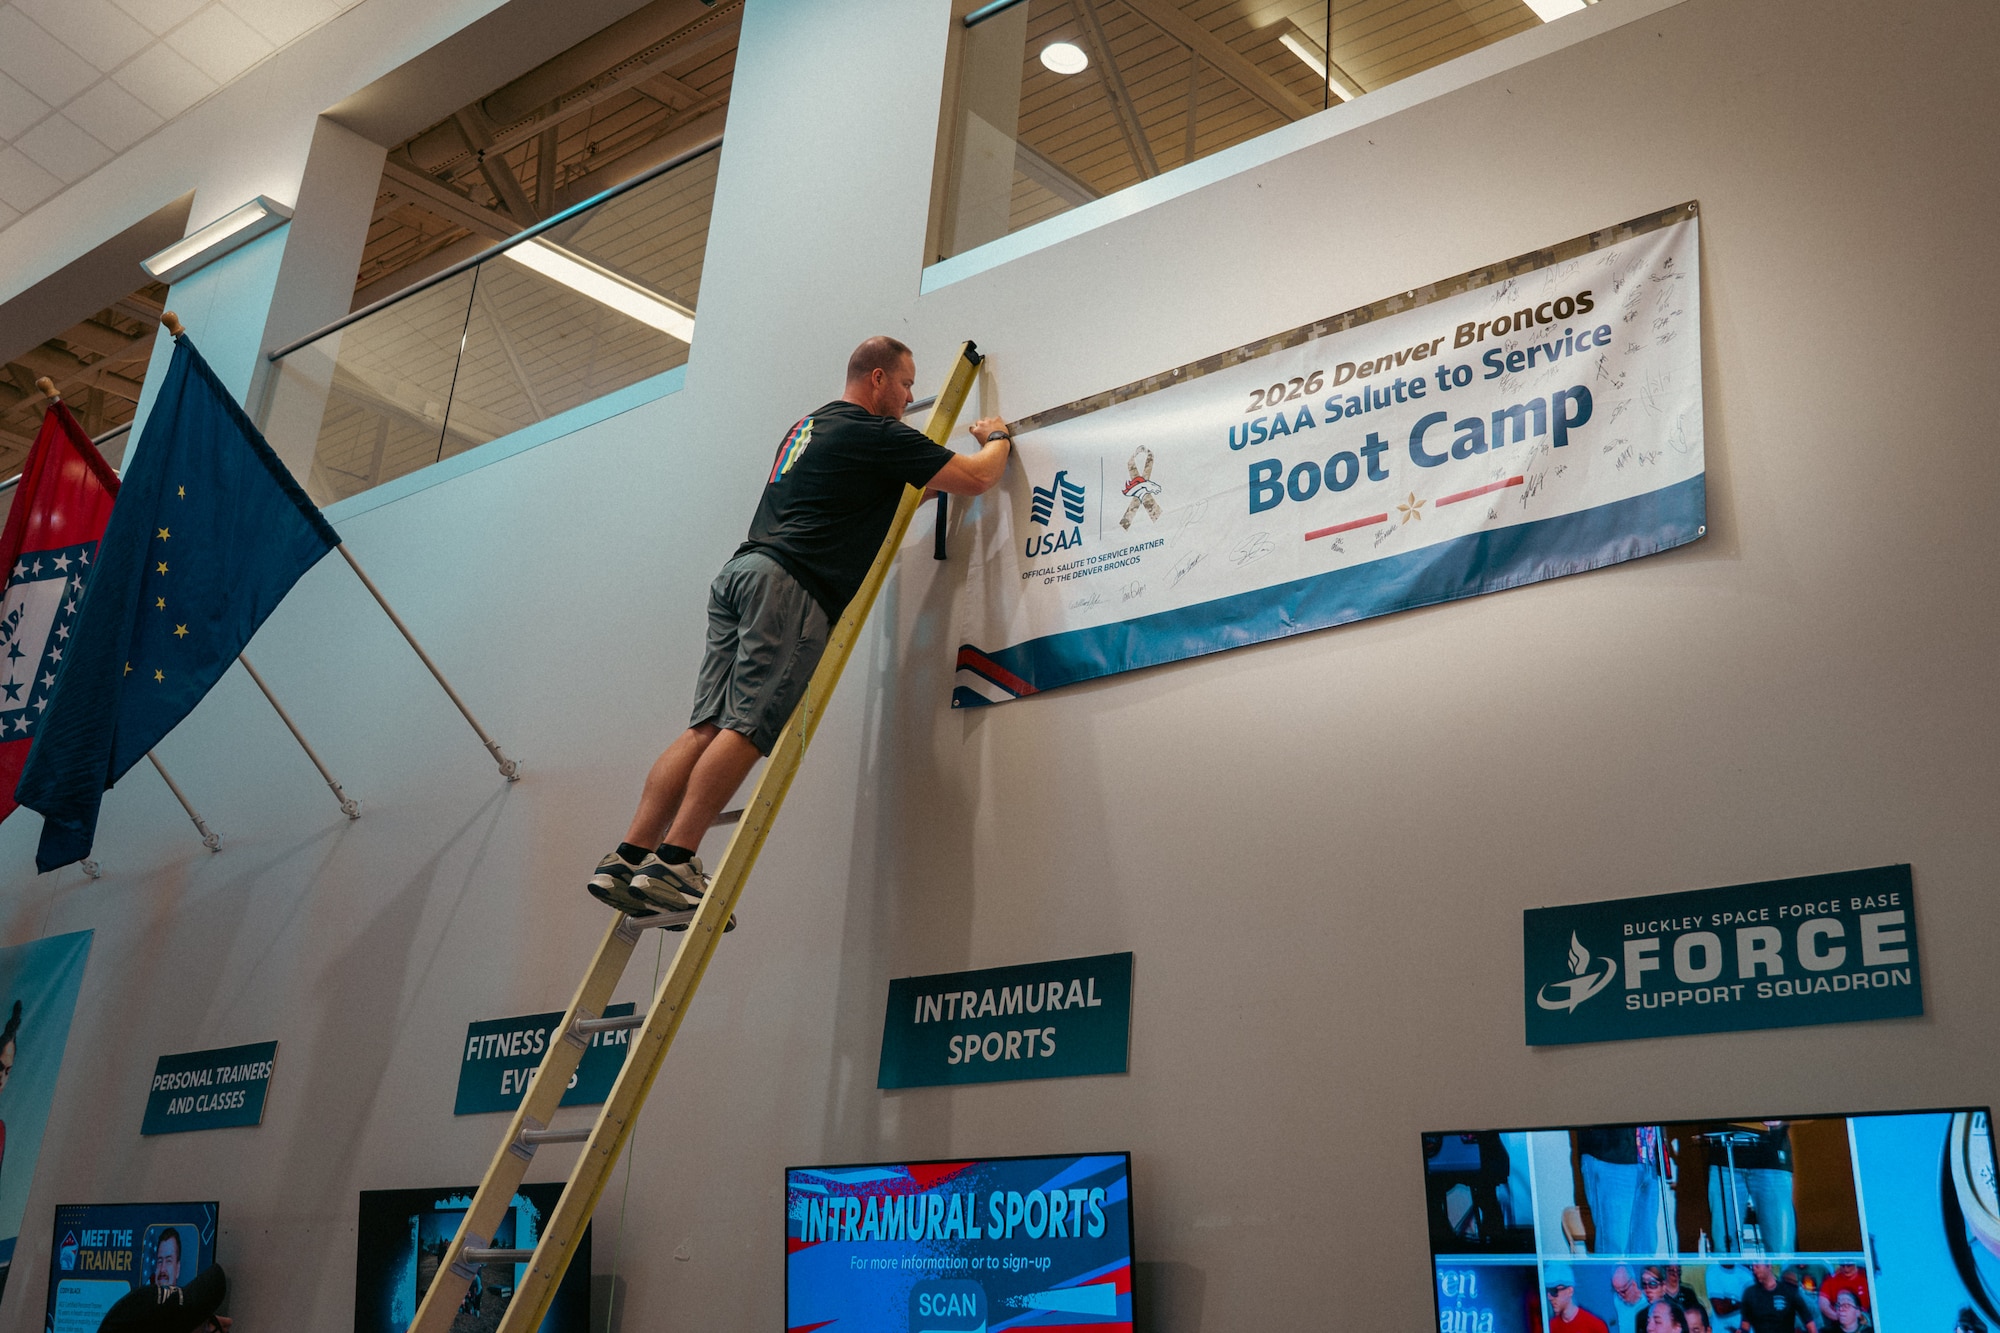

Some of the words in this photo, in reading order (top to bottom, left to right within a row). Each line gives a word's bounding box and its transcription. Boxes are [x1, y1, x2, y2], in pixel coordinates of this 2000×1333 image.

[1245, 370, 1324, 413] 2026
[1332, 336, 1445, 387] Denver
[1453, 290, 1594, 350] Broncos
[1229, 404, 1316, 451] USAA
[1324, 376, 1426, 424] Salute
[1435, 363, 1473, 393] to
[1482, 323, 1612, 380] Service
[1249, 431, 1390, 515] Boot
[1408, 384, 1593, 468] Camp
[1022, 566, 1055, 580] OFFICIAL
[1057, 558, 1085, 573] SALUTE
[1086, 556, 1097, 565] TO
[1097, 547, 1128, 562] SERVICE
[1129, 538, 1164, 554] PARTNER
[1025, 526, 1083, 558] USAA
[1043, 577, 1055, 585] OF
[1057, 572, 1071, 583] THE
[1072, 565, 1103, 579] DENVER
[1104, 555, 1141, 571] BRONCOS
[1623, 916, 1703, 936] BUCKLEY
[1711, 908, 1770, 926] SPACE
[1779, 900, 1841, 919] FORCE
[1851, 892, 1901, 910] BASE
[1623, 909, 1909, 990] FORCE
[913, 977, 1102, 1024] INTRAMURAL
[1625, 984, 1745, 1011] SUPPORT
[1757, 968, 1912, 1000] SQUADRON
[466, 1028, 546, 1061] FITNESS
[947, 1027, 1057, 1065] SPORTS
[152, 1069, 213, 1092] PERSONAL
[216, 1060, 273, 1085] TRAINERS
[166, 1096, 194, 1115] AND
[196, 1090, 246, 1112] CLASSES
[800, 1193, 982, 1242] INTRAMURAL
[987, 1187, 1107, 1239] SPORTS
[81, 1229, 110, 1247] MEET
[112, 1229, 133, 1247] THE
[80, 1250, 133, 1271] TRAINER
[850, 1256, 867, 1270] For
[870, 1259, 898, 1270] more
[901, 1254, 969, 1270] information
[971, 1258, 985, 1269] or
[986, 1255, 1000, 1269] to
[1002, 1253, 1051, 1272] sign-up
[919, 1293, 977, 1317] SCAN
